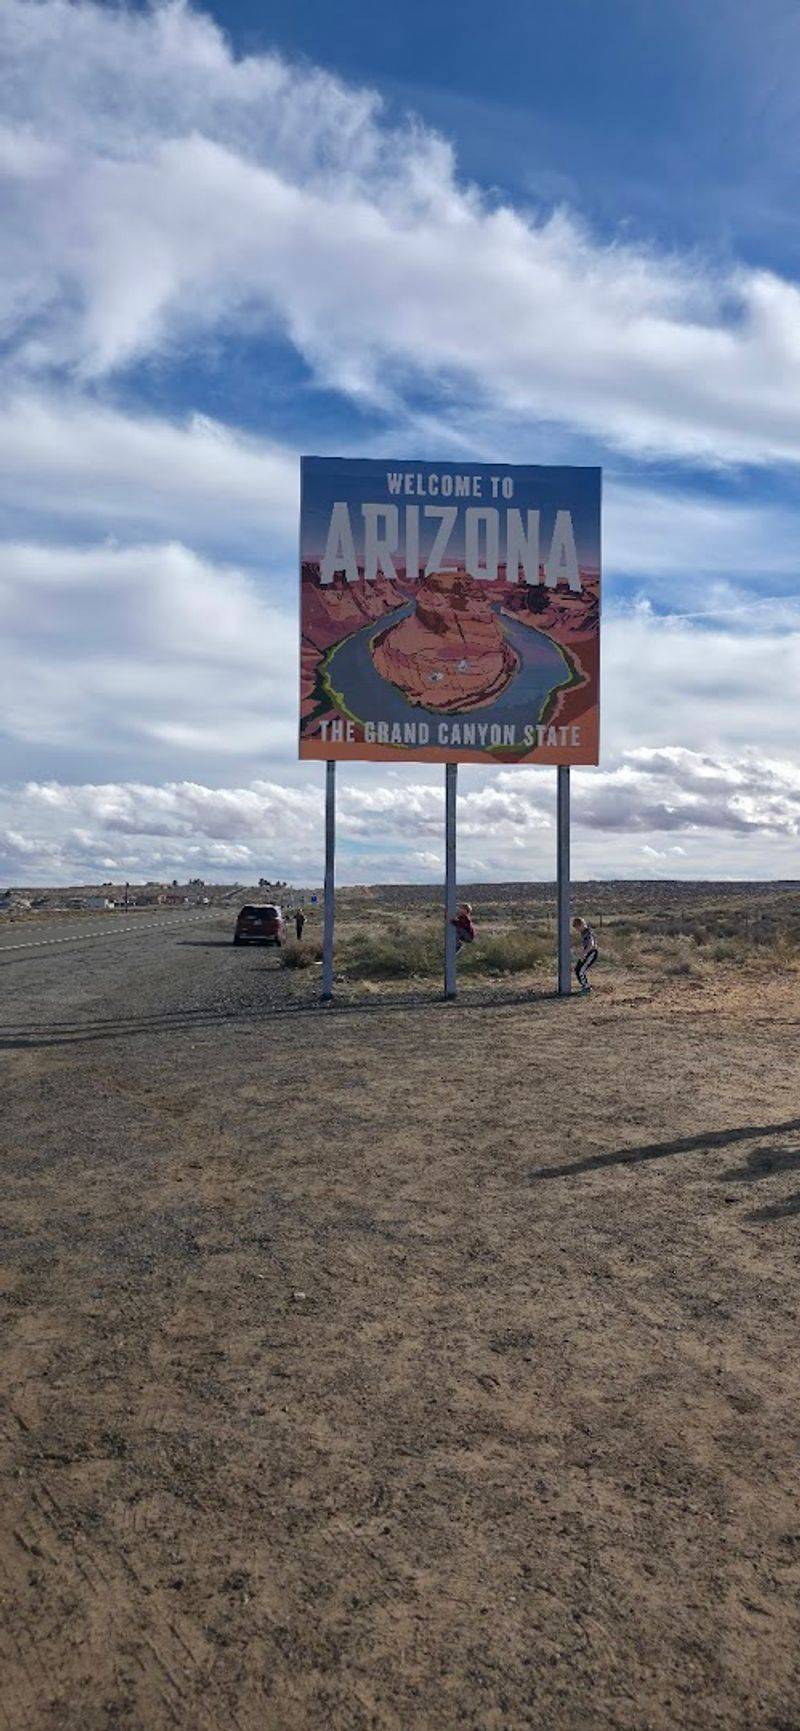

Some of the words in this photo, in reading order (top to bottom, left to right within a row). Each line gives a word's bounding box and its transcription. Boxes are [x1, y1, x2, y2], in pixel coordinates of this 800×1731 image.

[387, 472, 482, 498] WELCOME
[490, 476, 514, 499] TO
[319, 502, 583, 593] ARIZONA
[319, 720, 355, 744] THE
[364, 721, 430, 746] GRAND
[438, 722, 516, 746] CANYON
[523, 724, 581, 748] STATE
